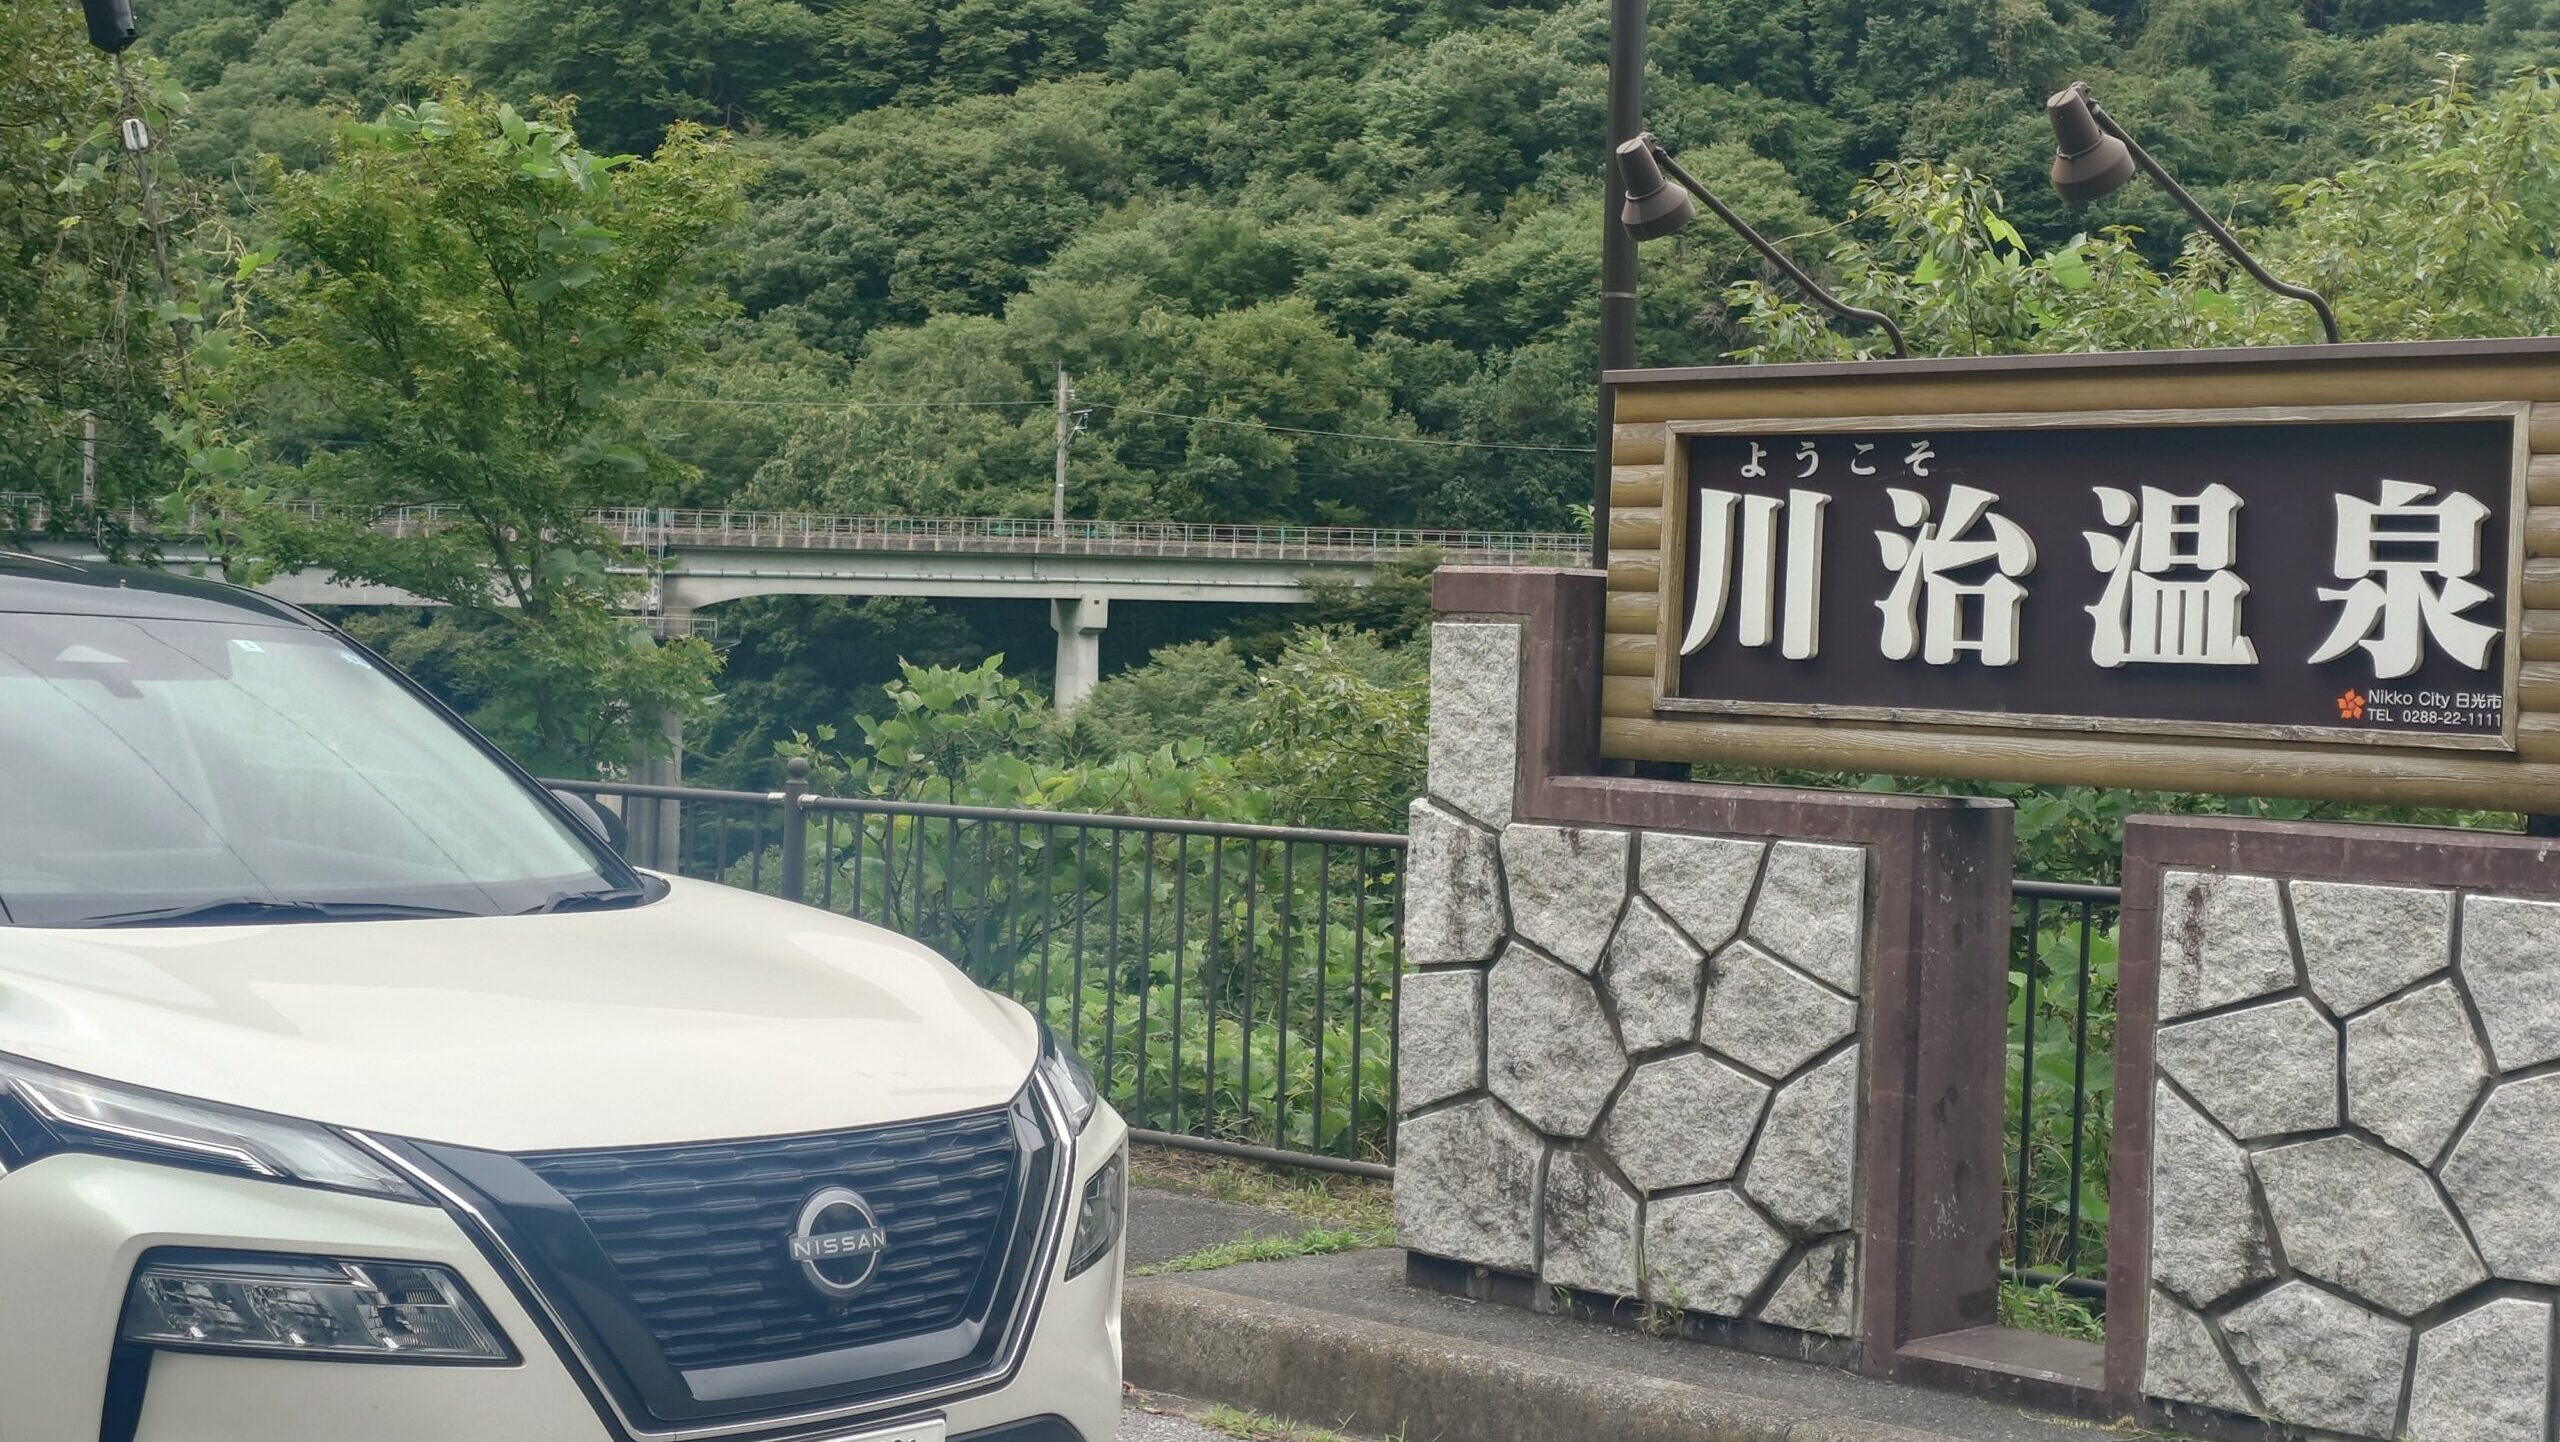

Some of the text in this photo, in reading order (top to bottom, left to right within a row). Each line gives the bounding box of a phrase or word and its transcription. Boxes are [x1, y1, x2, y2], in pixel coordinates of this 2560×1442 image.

[1740, 440, 1936, 478] ようこそ
[1679, 479, 2503, 680] 川治温泉
[2368, 689, 2502, 710] Nikko City 日光市
[2367, 708, 2501, 727] TEL 0288-22-1111
[793, 1231, 885, 1257] NISSAN
